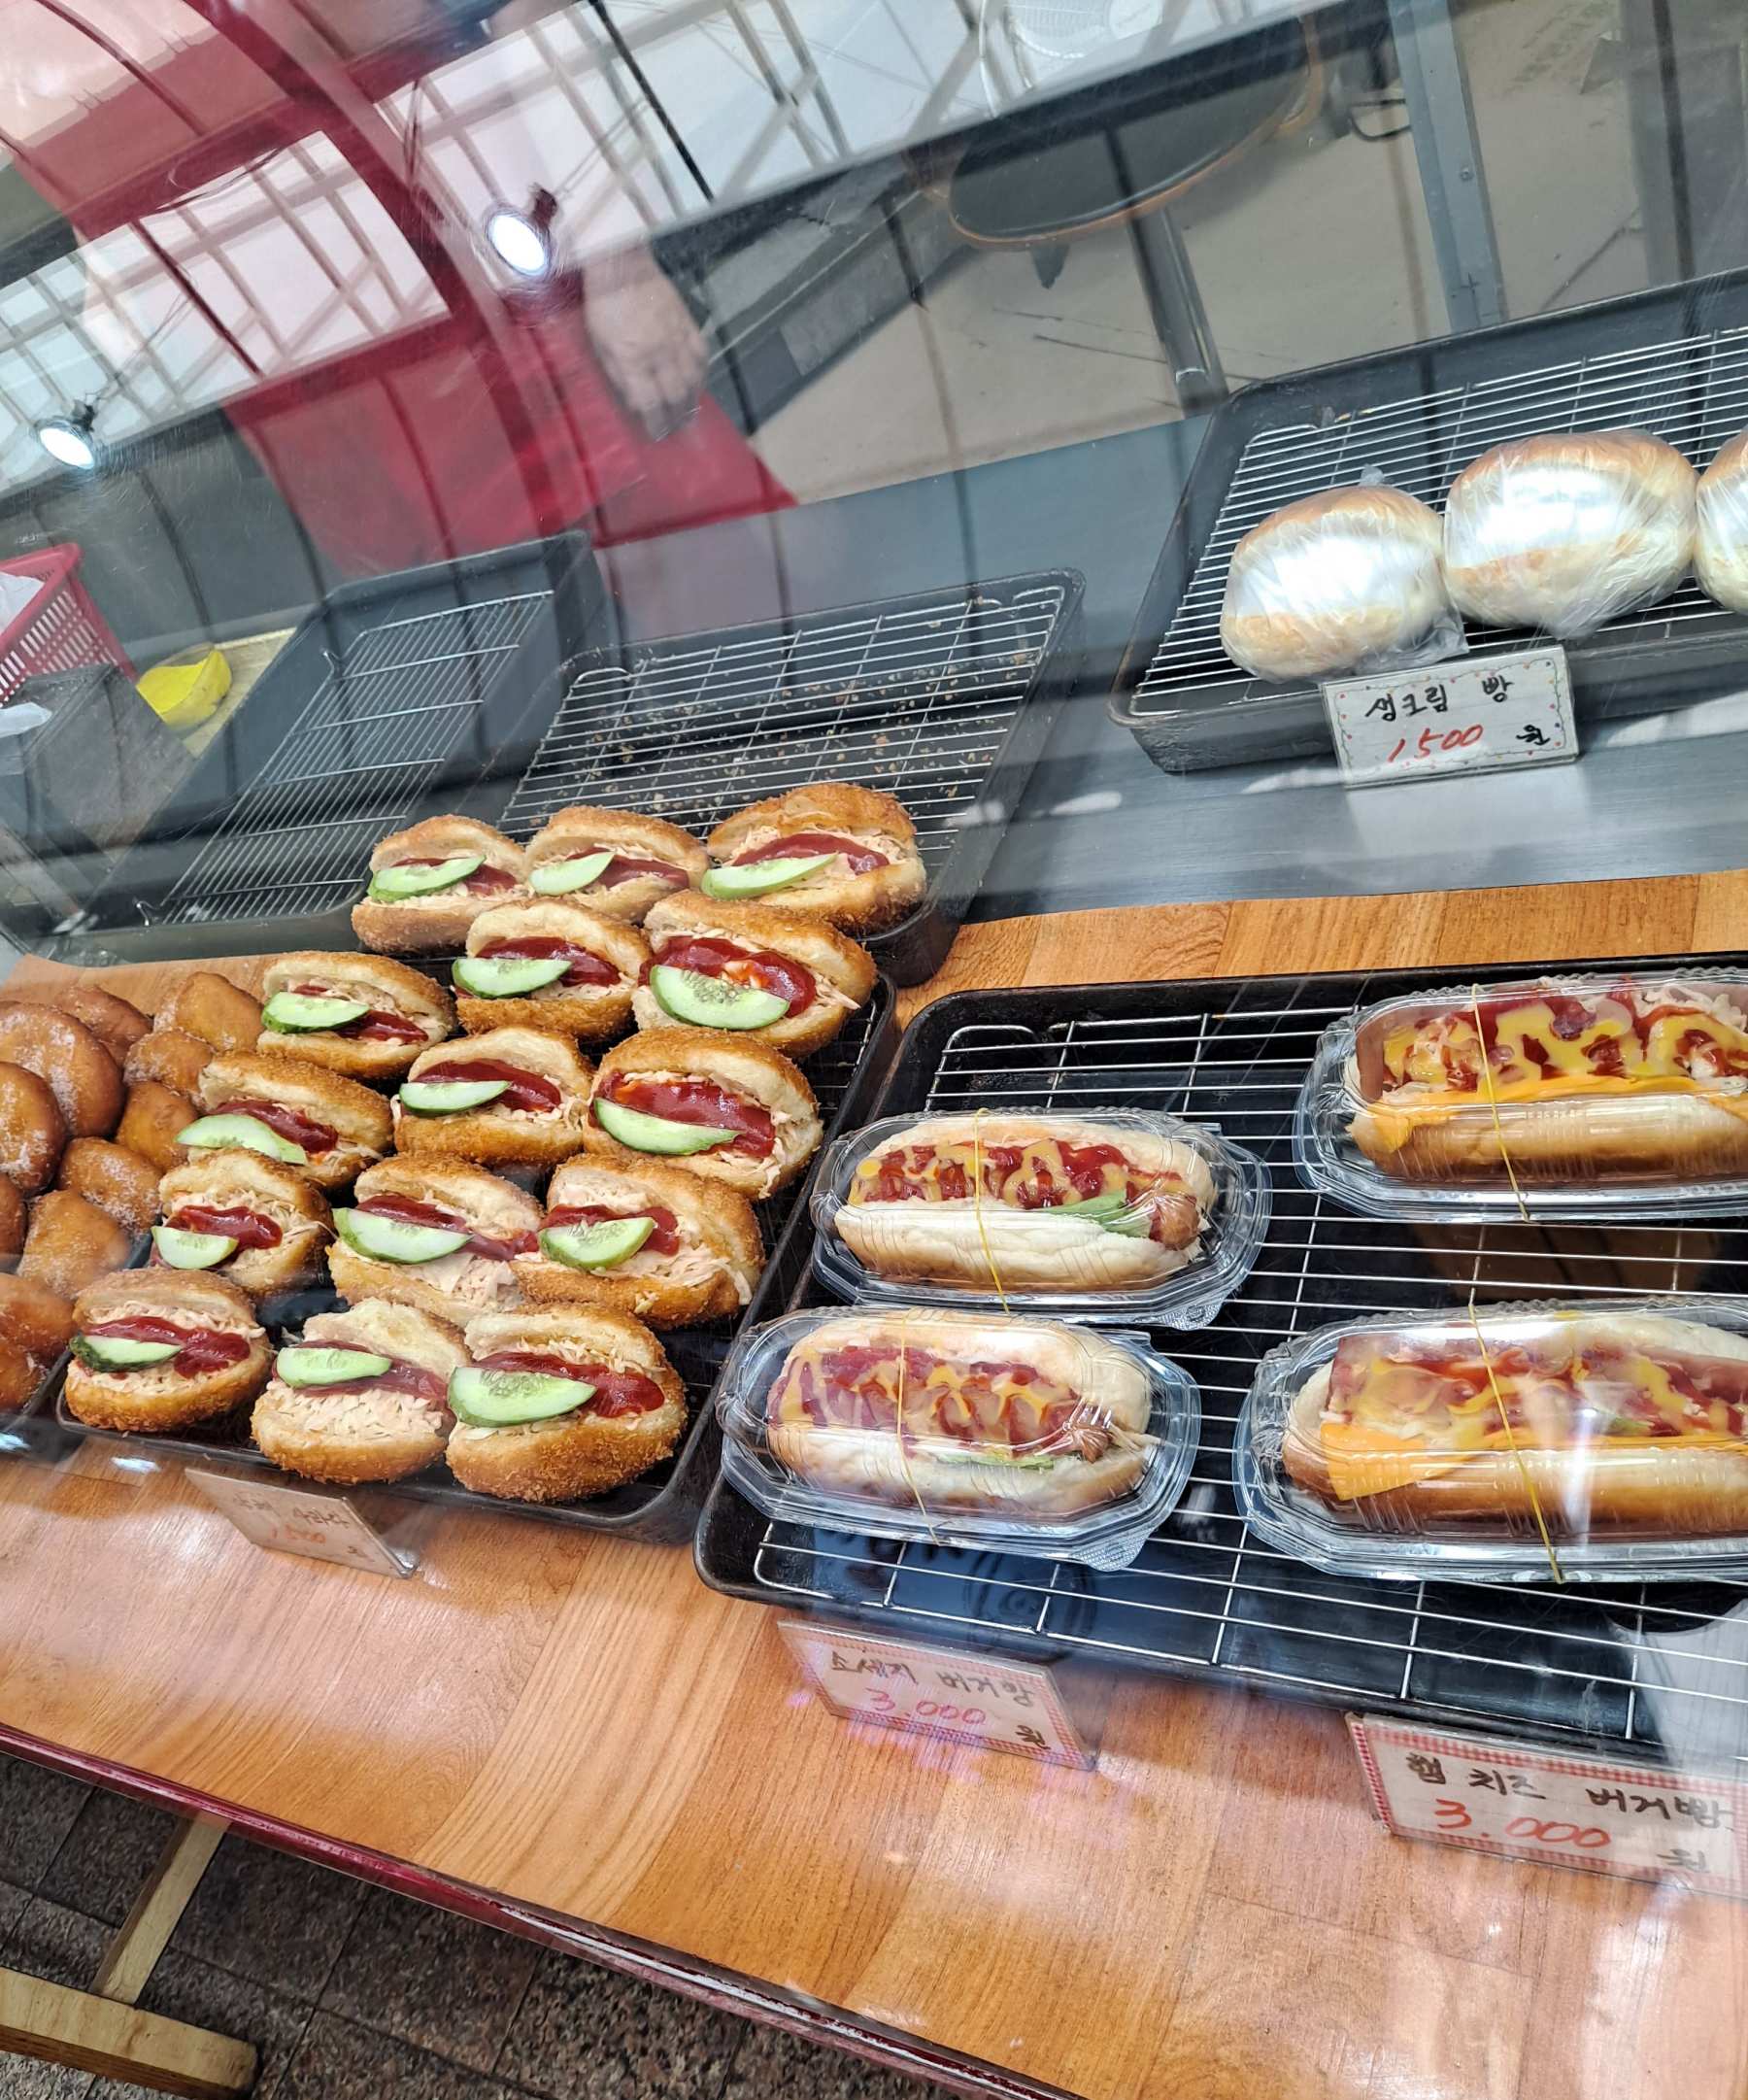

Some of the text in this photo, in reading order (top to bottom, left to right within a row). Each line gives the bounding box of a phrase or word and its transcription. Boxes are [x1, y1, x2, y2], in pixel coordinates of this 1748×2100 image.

[1481, 675, 1515, 702] 빵
[1387, 723, 1484, 763] 1500
[1404, 1751, 1447, 1785] 햄
[1468, 1768, 1546, 1800] 치즈
